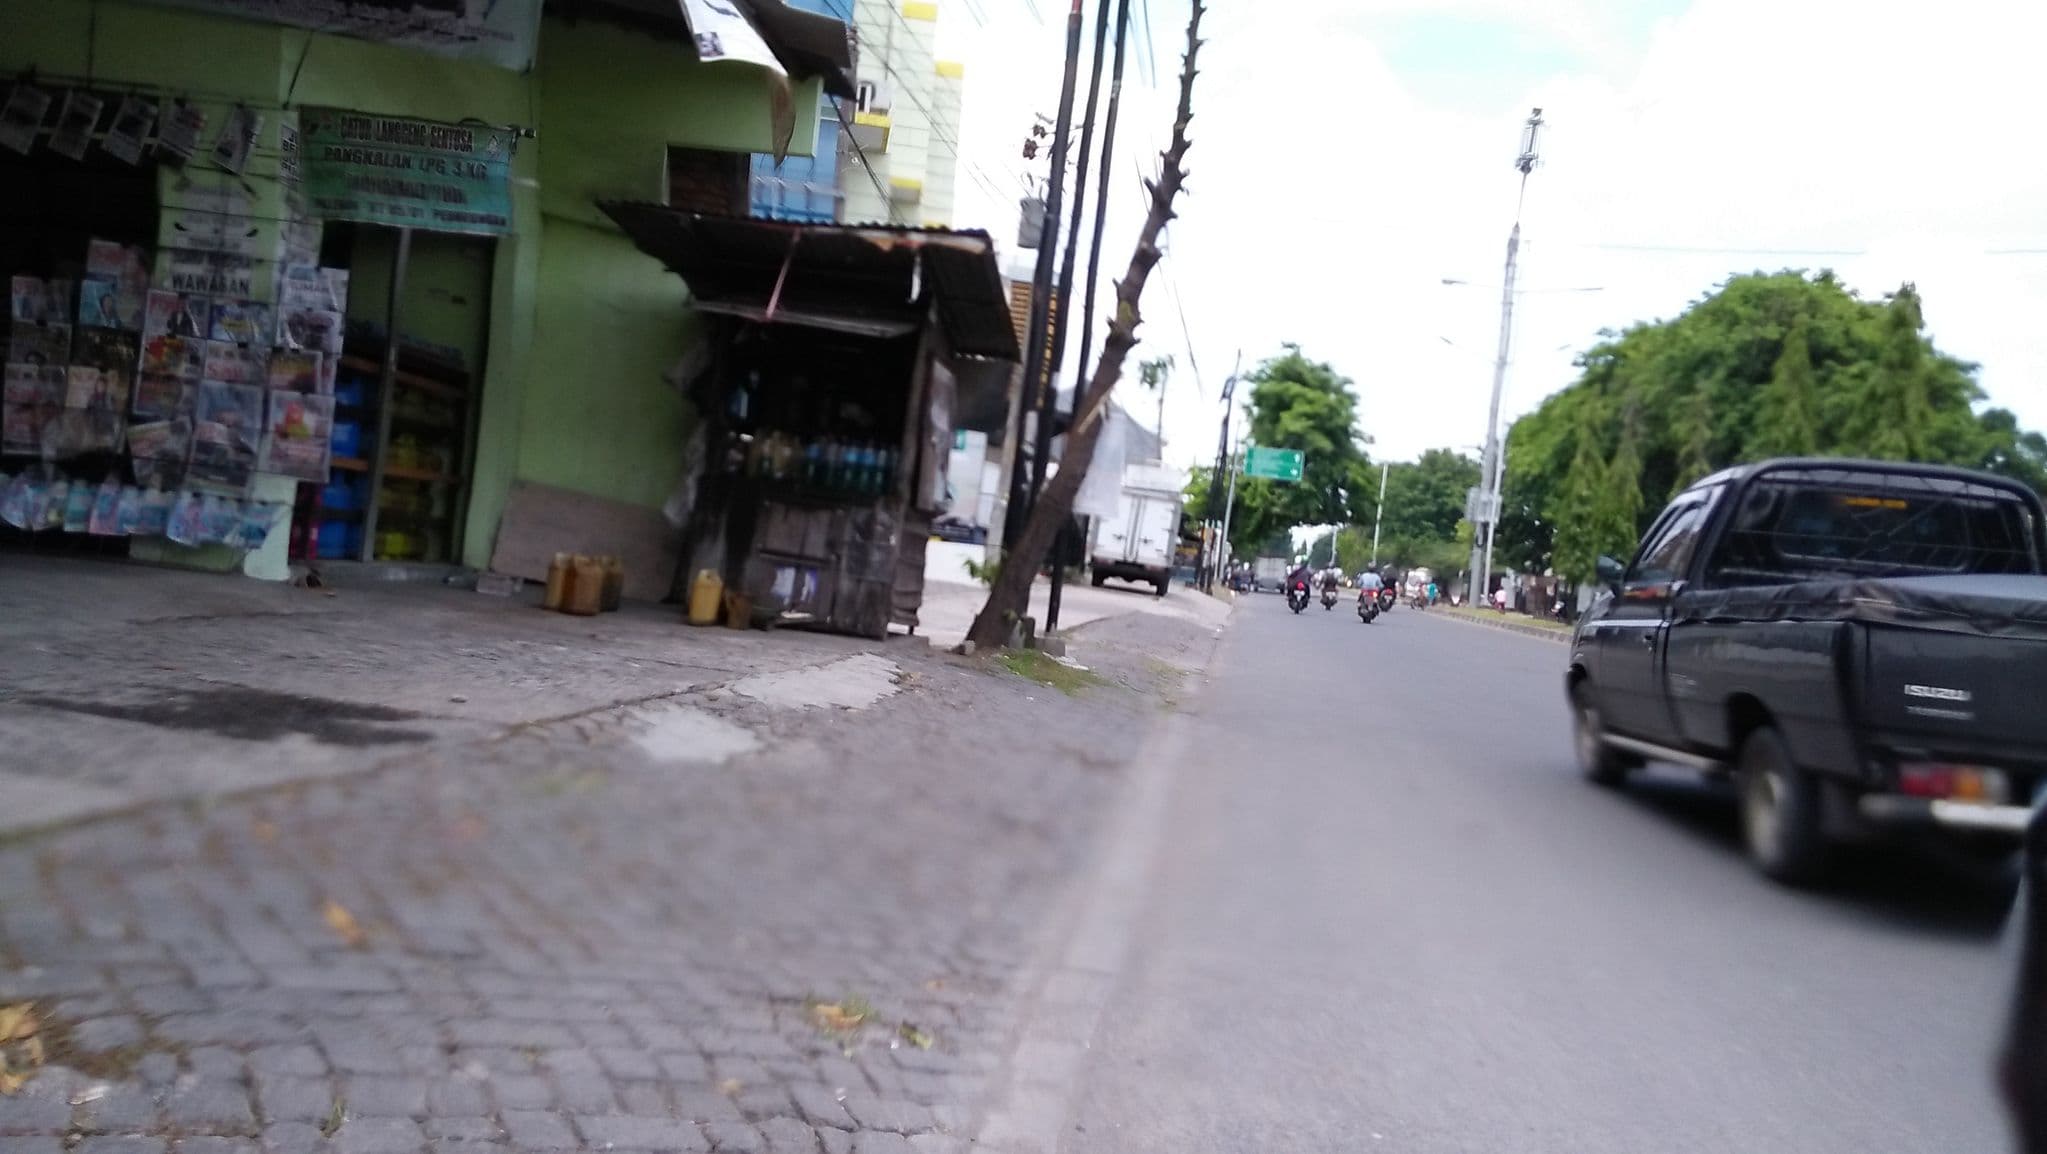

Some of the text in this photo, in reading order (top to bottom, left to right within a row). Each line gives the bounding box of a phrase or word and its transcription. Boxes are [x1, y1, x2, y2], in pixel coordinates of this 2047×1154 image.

[431, 126, 474, 152] SENTOSA
[323, 147, 488, 181] PANGKALAN LPG 3 KG
[172, 273, 250, 295] WAWASAN
[1903, 684, 1972, 701] ISUZU
